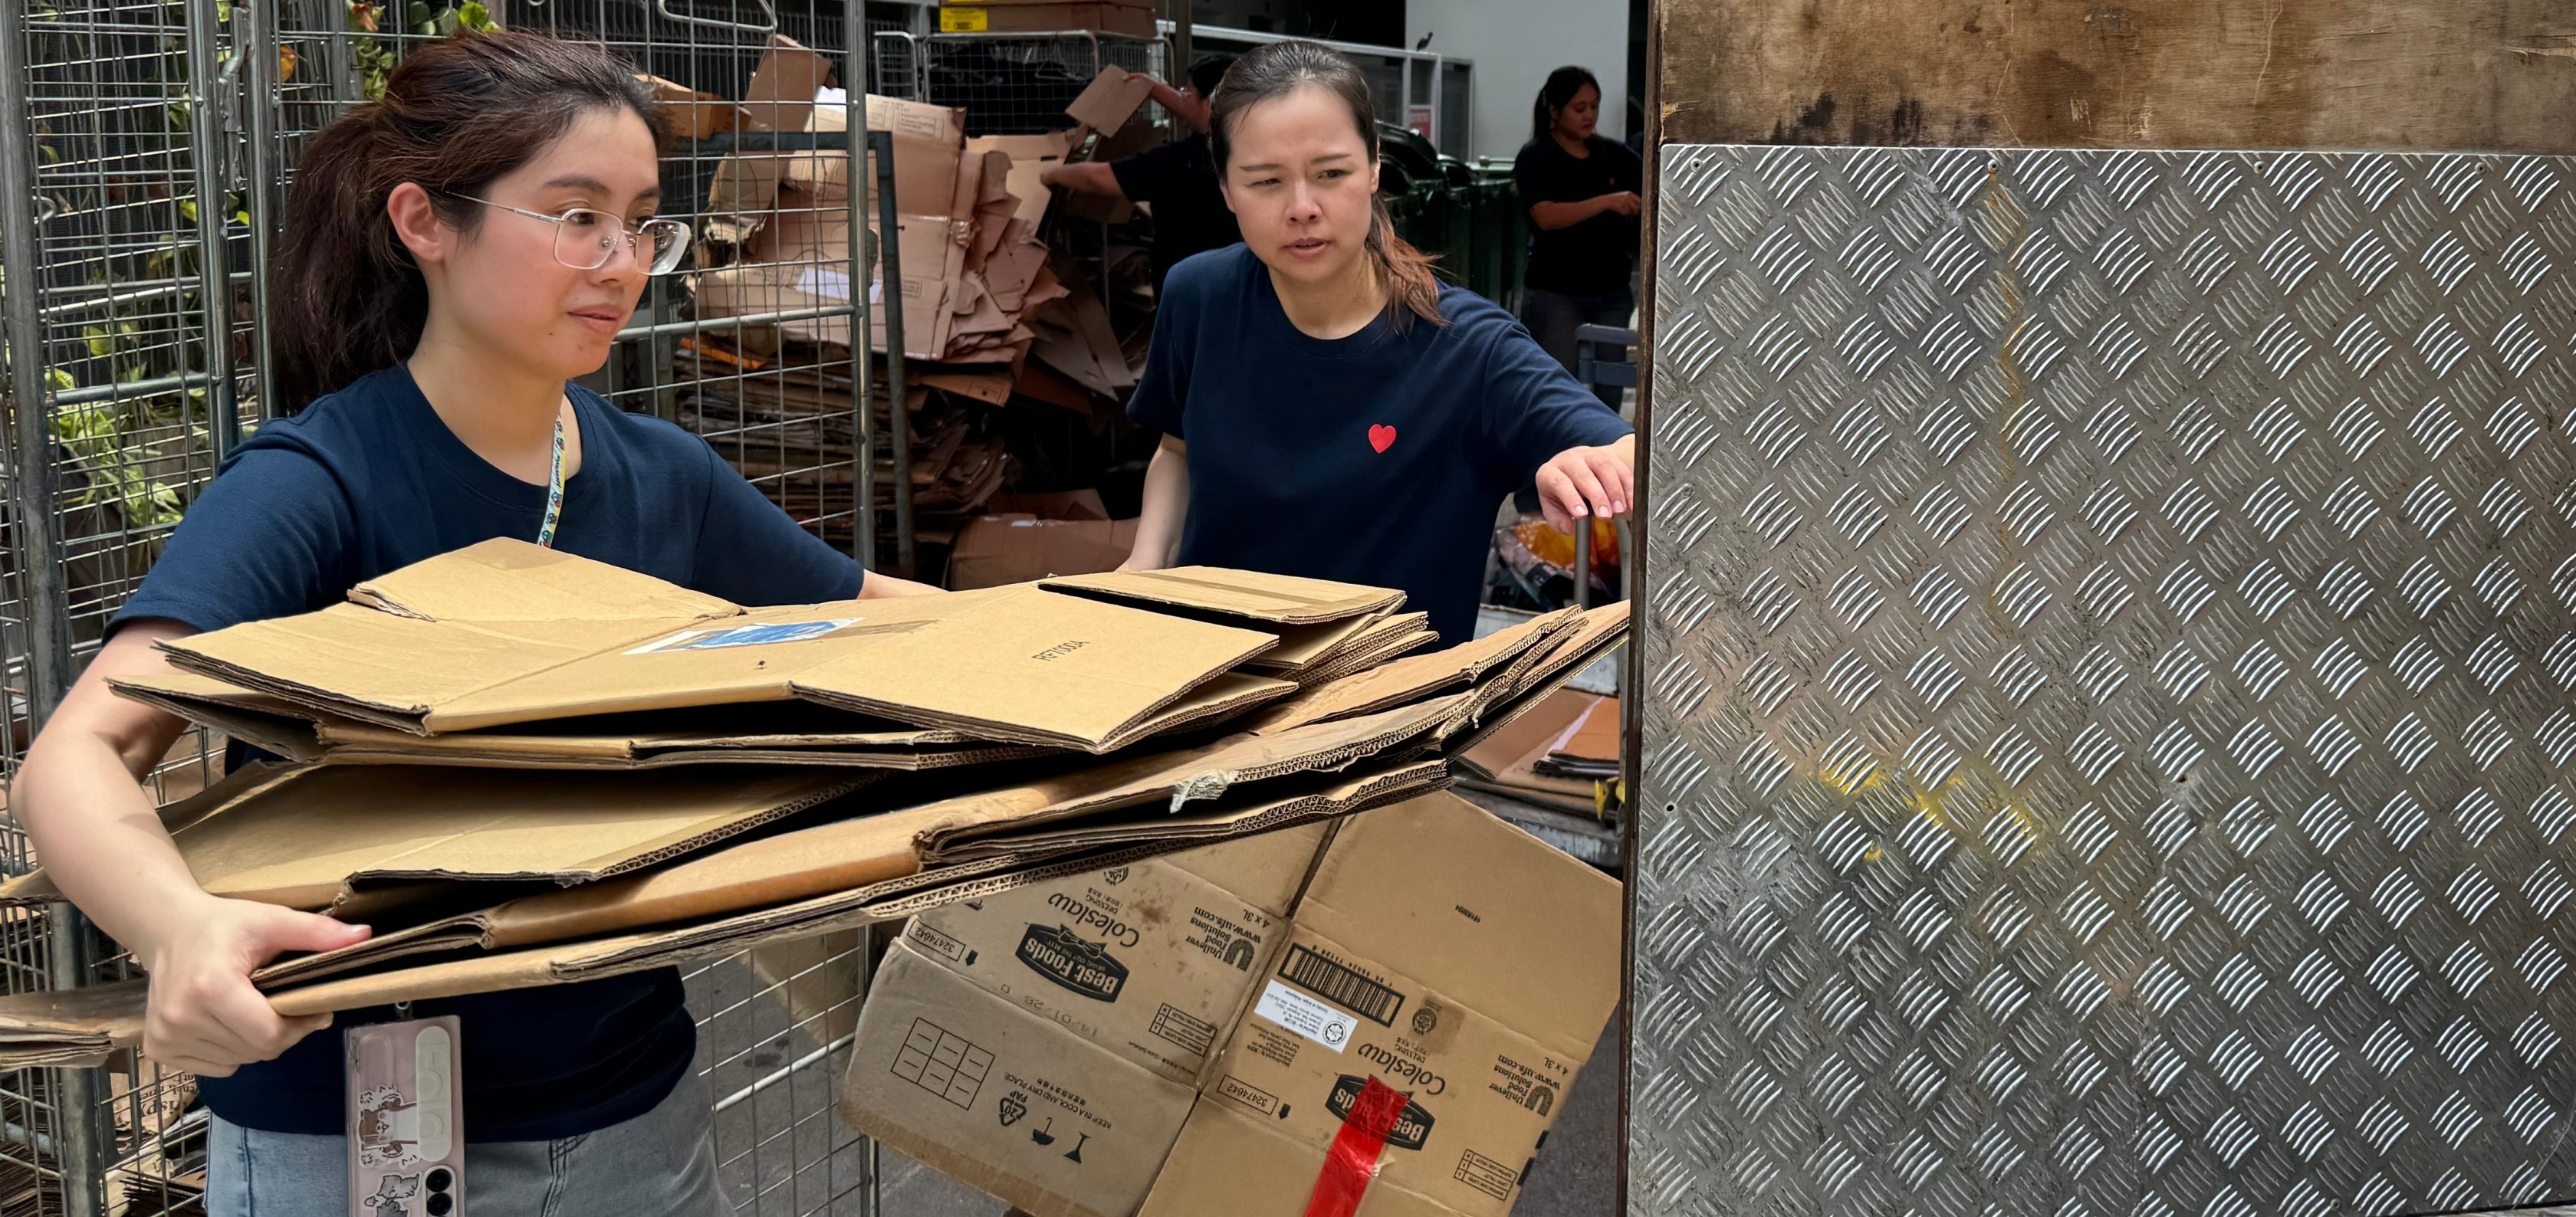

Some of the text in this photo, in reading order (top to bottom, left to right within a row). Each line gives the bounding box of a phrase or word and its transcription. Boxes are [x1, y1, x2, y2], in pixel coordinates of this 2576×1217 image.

[1048, 893, 1139, 947] Coleslaw
[1194, 907, 1260, 943] www.ufs.com
[1244, 909, 1254, 921] 3L
[1262, 919, 1270, 928] 4
[1190, 917, 1231, 943] Solutions
[1185, 936, 1222, 959] Unilever
[1204, 935, 1227, 951] Food
[1025, 938, 1119, 993] Best Foods
[1358, 1043, 1445, 1095] Coleslaw
[1498, 1055, 1559, 1091] www.ufs.com
[1545, 1057, 1555, 1069] 3L
[1493, 1064, 1533, 1088] Solutions
[1009, 1091, 1028, 1103] PAP
[1489, 1083, 1523, 1104] Unilever
[1507, 1081, 1529, 1097] Food
[1060, 1099, 1078, 1113] COOL
